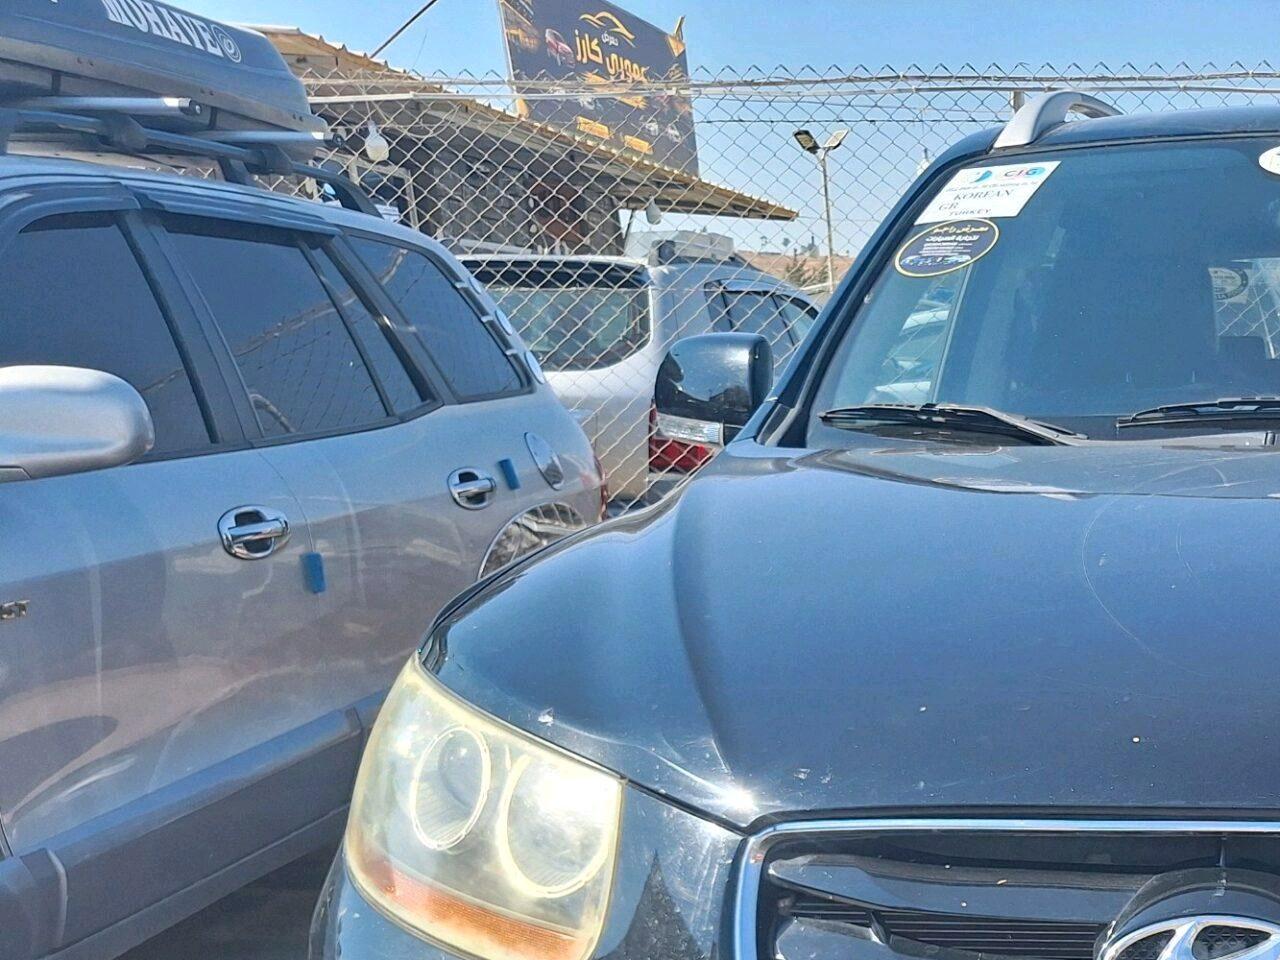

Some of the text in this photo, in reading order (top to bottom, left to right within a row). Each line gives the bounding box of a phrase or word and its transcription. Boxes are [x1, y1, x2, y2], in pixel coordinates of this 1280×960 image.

[103, 0, 224, 57] MOHAVE
[574, 29, 604, 64] كارز
[954, 189, 1015, 201] KOREAN
